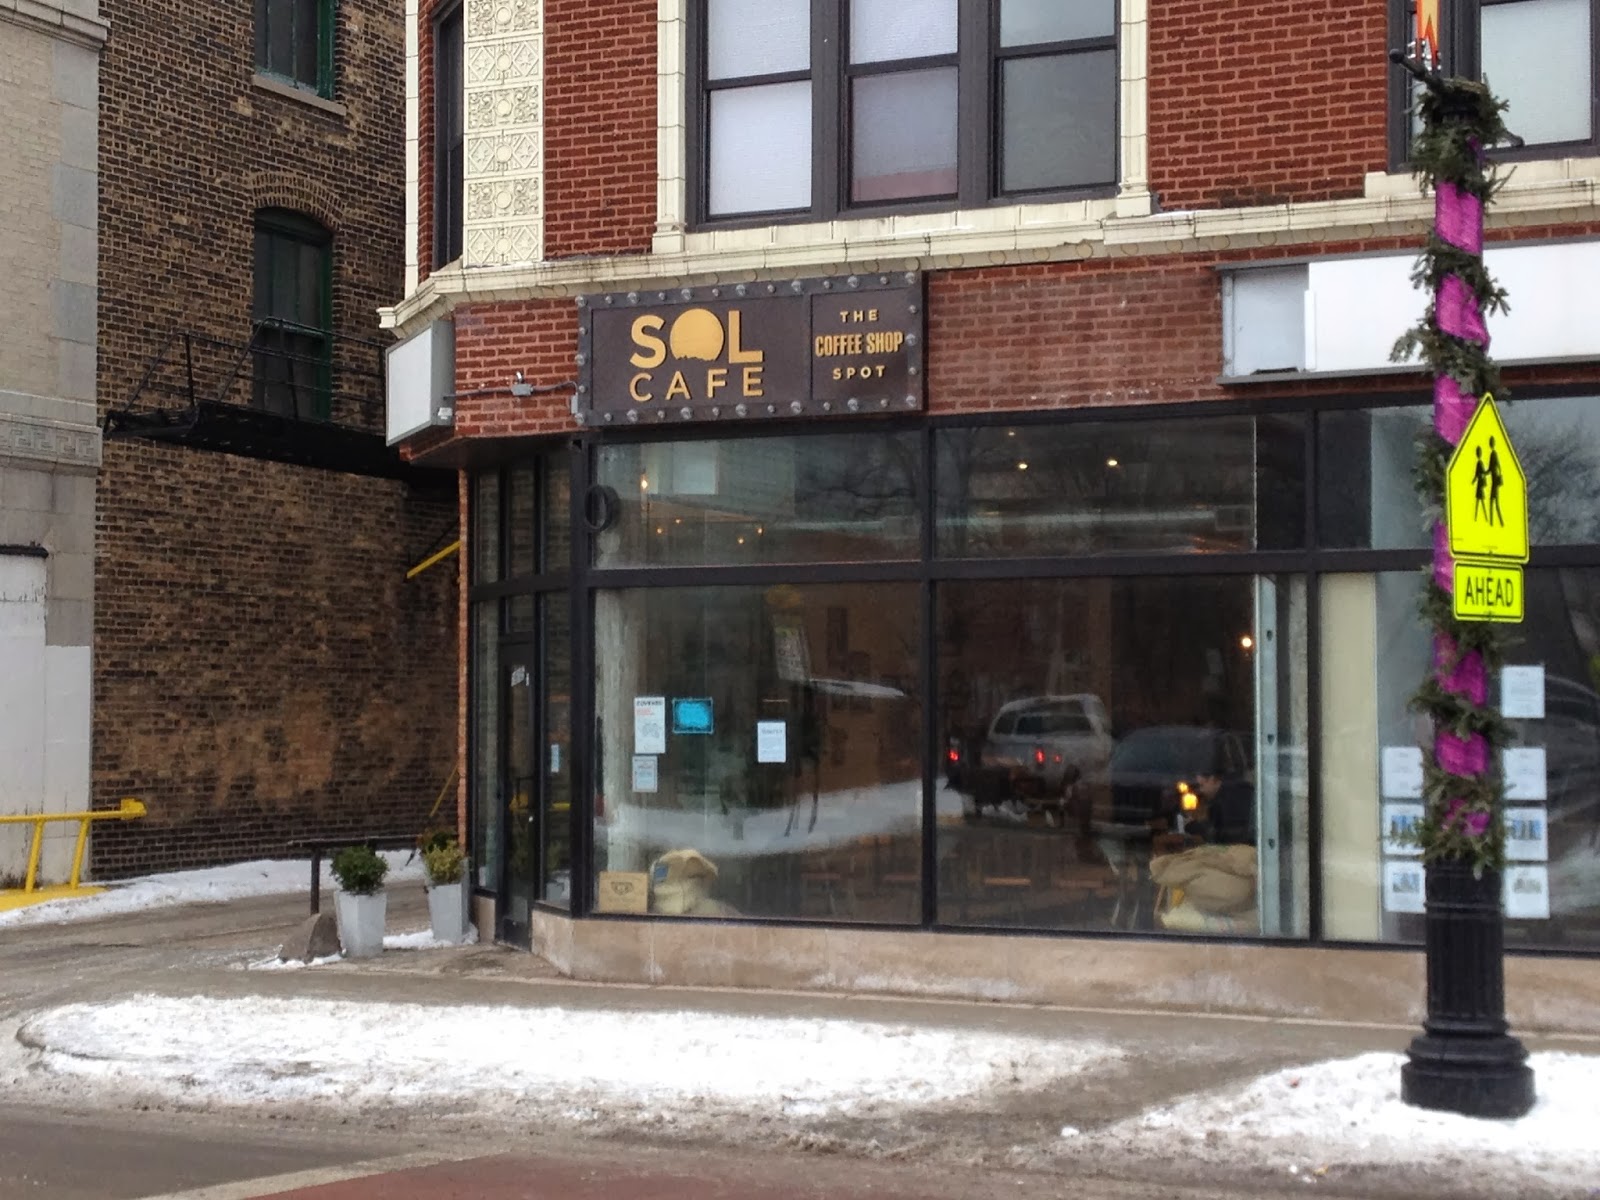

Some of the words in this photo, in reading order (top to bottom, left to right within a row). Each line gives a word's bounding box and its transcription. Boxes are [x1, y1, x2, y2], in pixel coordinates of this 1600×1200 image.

[840, 309, 878, 323] THE
[629, 308, 764, 368] SOL
[815, 334, 863, 357] COFFEE
[866, 331, 904, 354] SHOP
[629, 366, 764, 402] CAFE
[832, 365, 885, 380] SPOT
[1464, 576, 1514, 608] AHEAD
